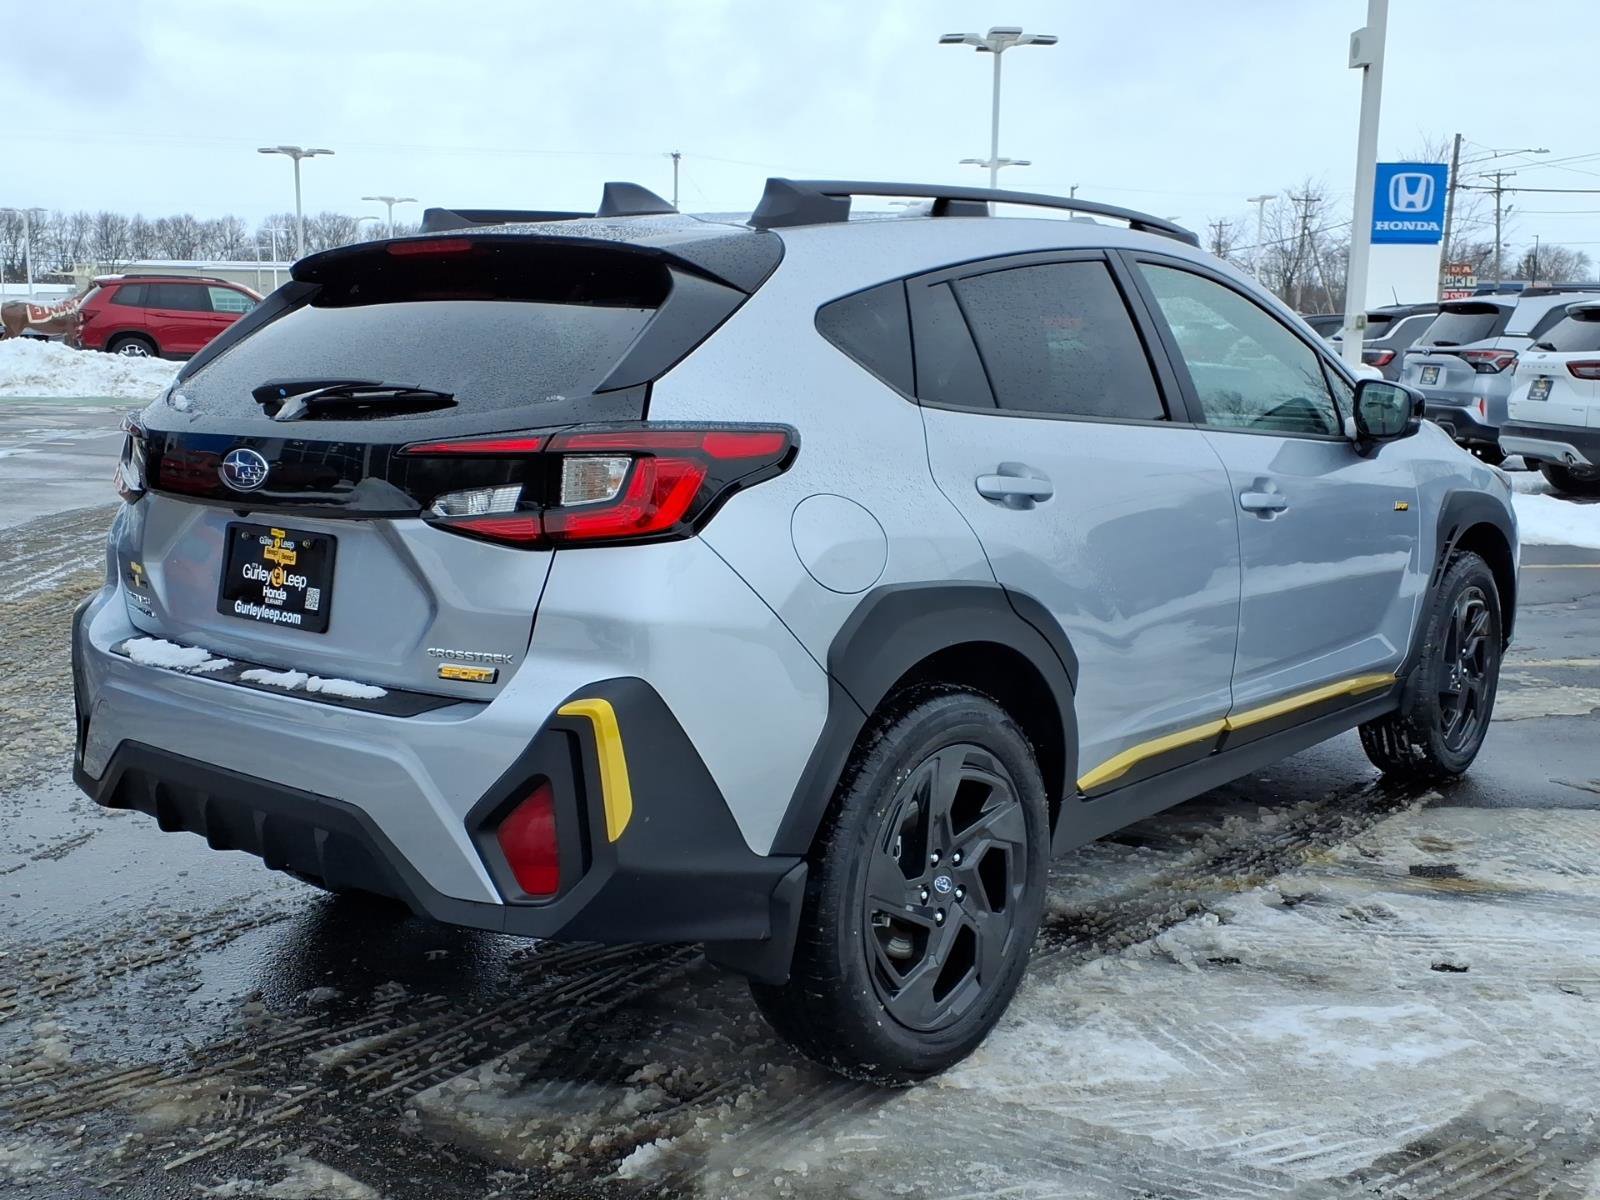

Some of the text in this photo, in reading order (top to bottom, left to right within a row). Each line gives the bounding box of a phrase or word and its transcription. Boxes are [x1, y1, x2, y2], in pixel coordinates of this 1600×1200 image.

[1375, 221, 1440, 231] HONDA
[242, 564, 307, 592] Gurley Leep
[262, 585, 287, 601] Honda
[234, 600, 302, 625] Gurleyleep.com
[426, 647, 514, 665] CROSSTREK
[441, 667, 493, 681] SPORT
